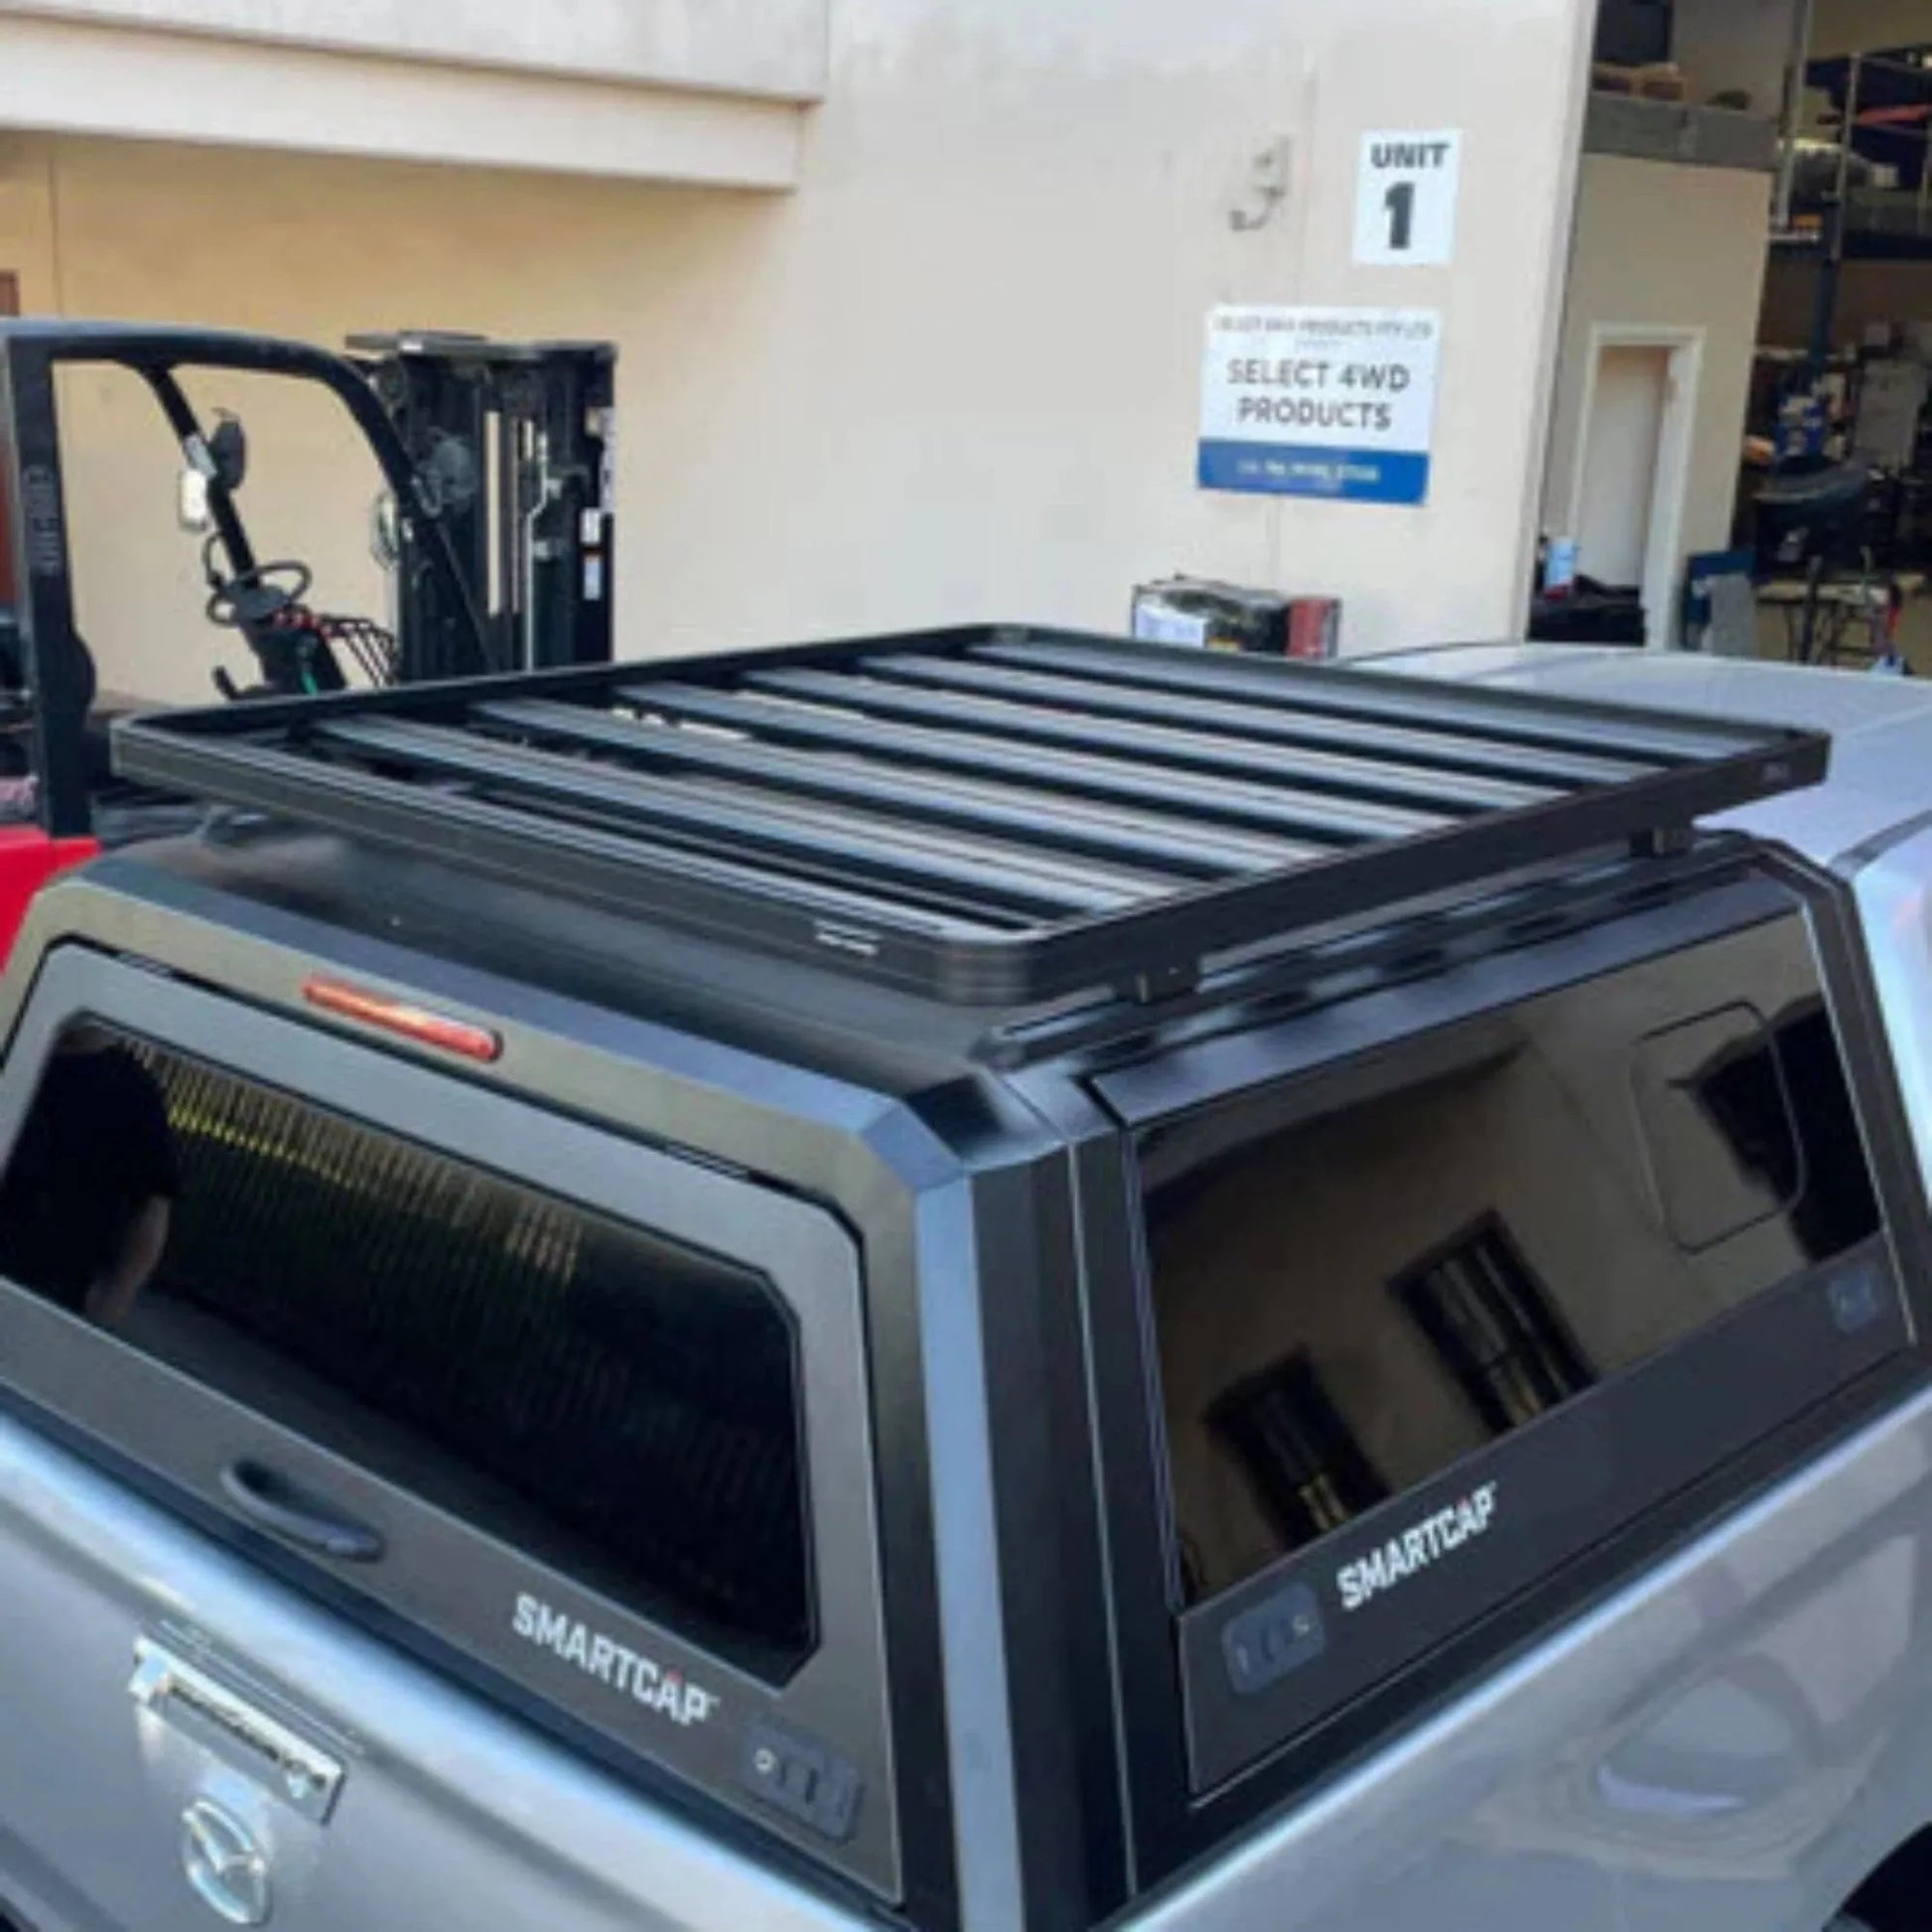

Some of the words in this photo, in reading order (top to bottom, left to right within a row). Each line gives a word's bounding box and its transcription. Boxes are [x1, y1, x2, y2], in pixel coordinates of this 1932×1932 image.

[1370, 142, 1450, 170] UNIT
[1384, 182, 1416, 249] 1
[1226, 358, 1329, 389] SELECT
[1337, 362, 1411, 393] 4WD
[1237, 396, 1392, 431] PRODUCTS
[1336, 1484, 1494, 1611] SMARTCAP
[511, 1591, 711, 1725] SMARTCAP
